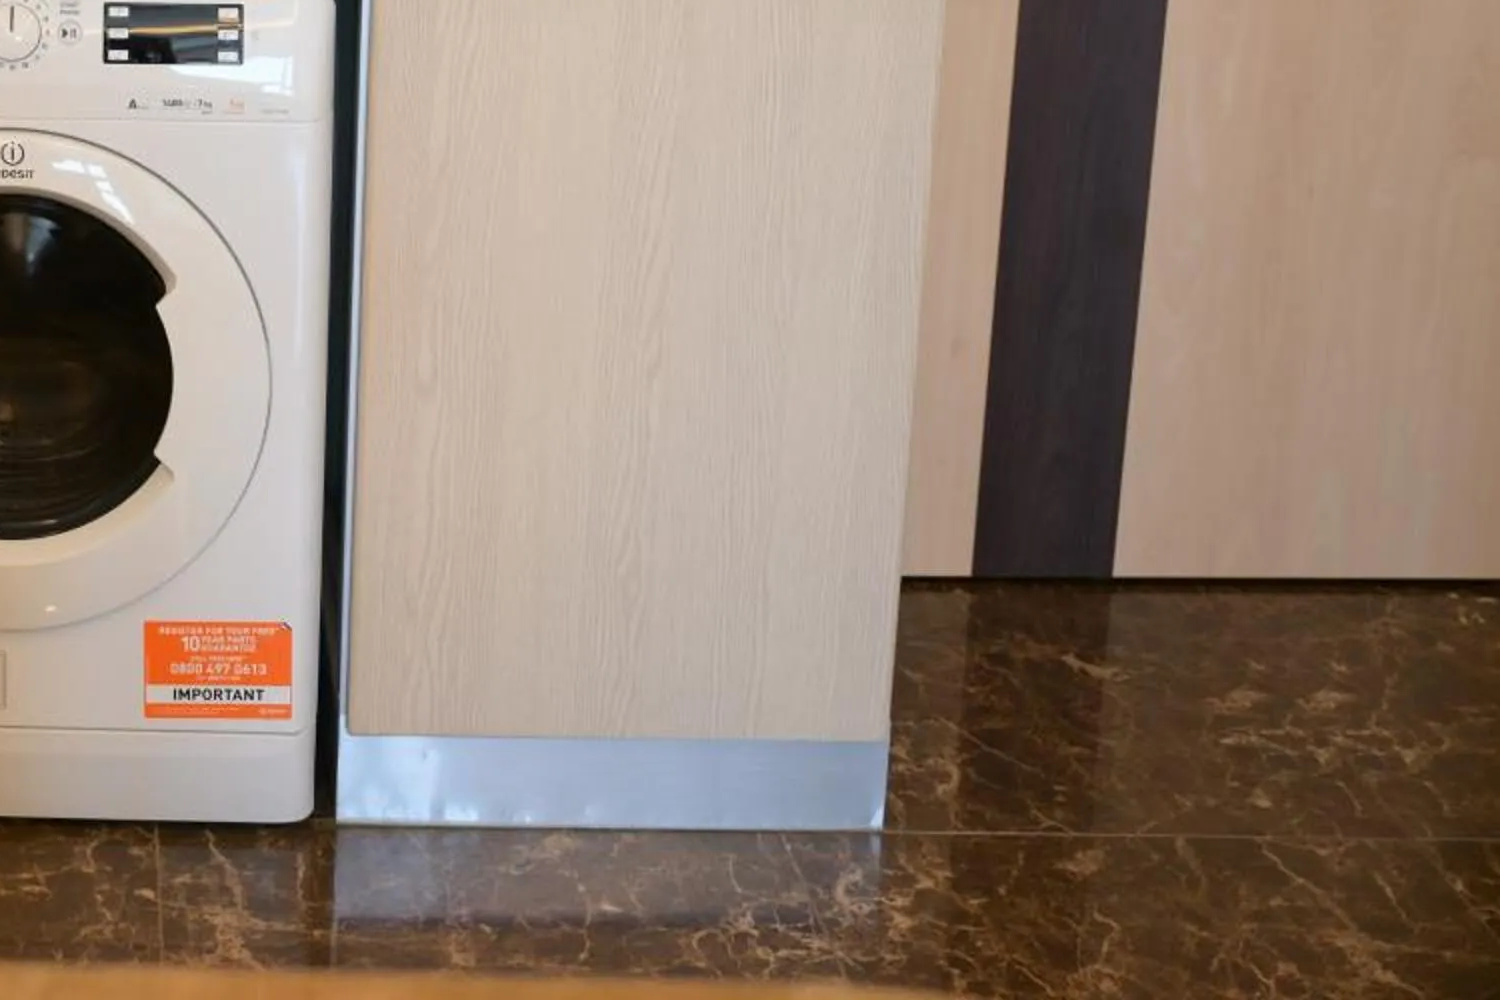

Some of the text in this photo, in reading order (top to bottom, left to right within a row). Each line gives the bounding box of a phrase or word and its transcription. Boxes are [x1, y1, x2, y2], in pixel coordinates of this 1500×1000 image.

[181, 635, 200, 653] 10
[169, 663, 203, 676] 0800
[205, 662, 232, 675] 497
[173, 688, 265, 701] IMPORTANT
